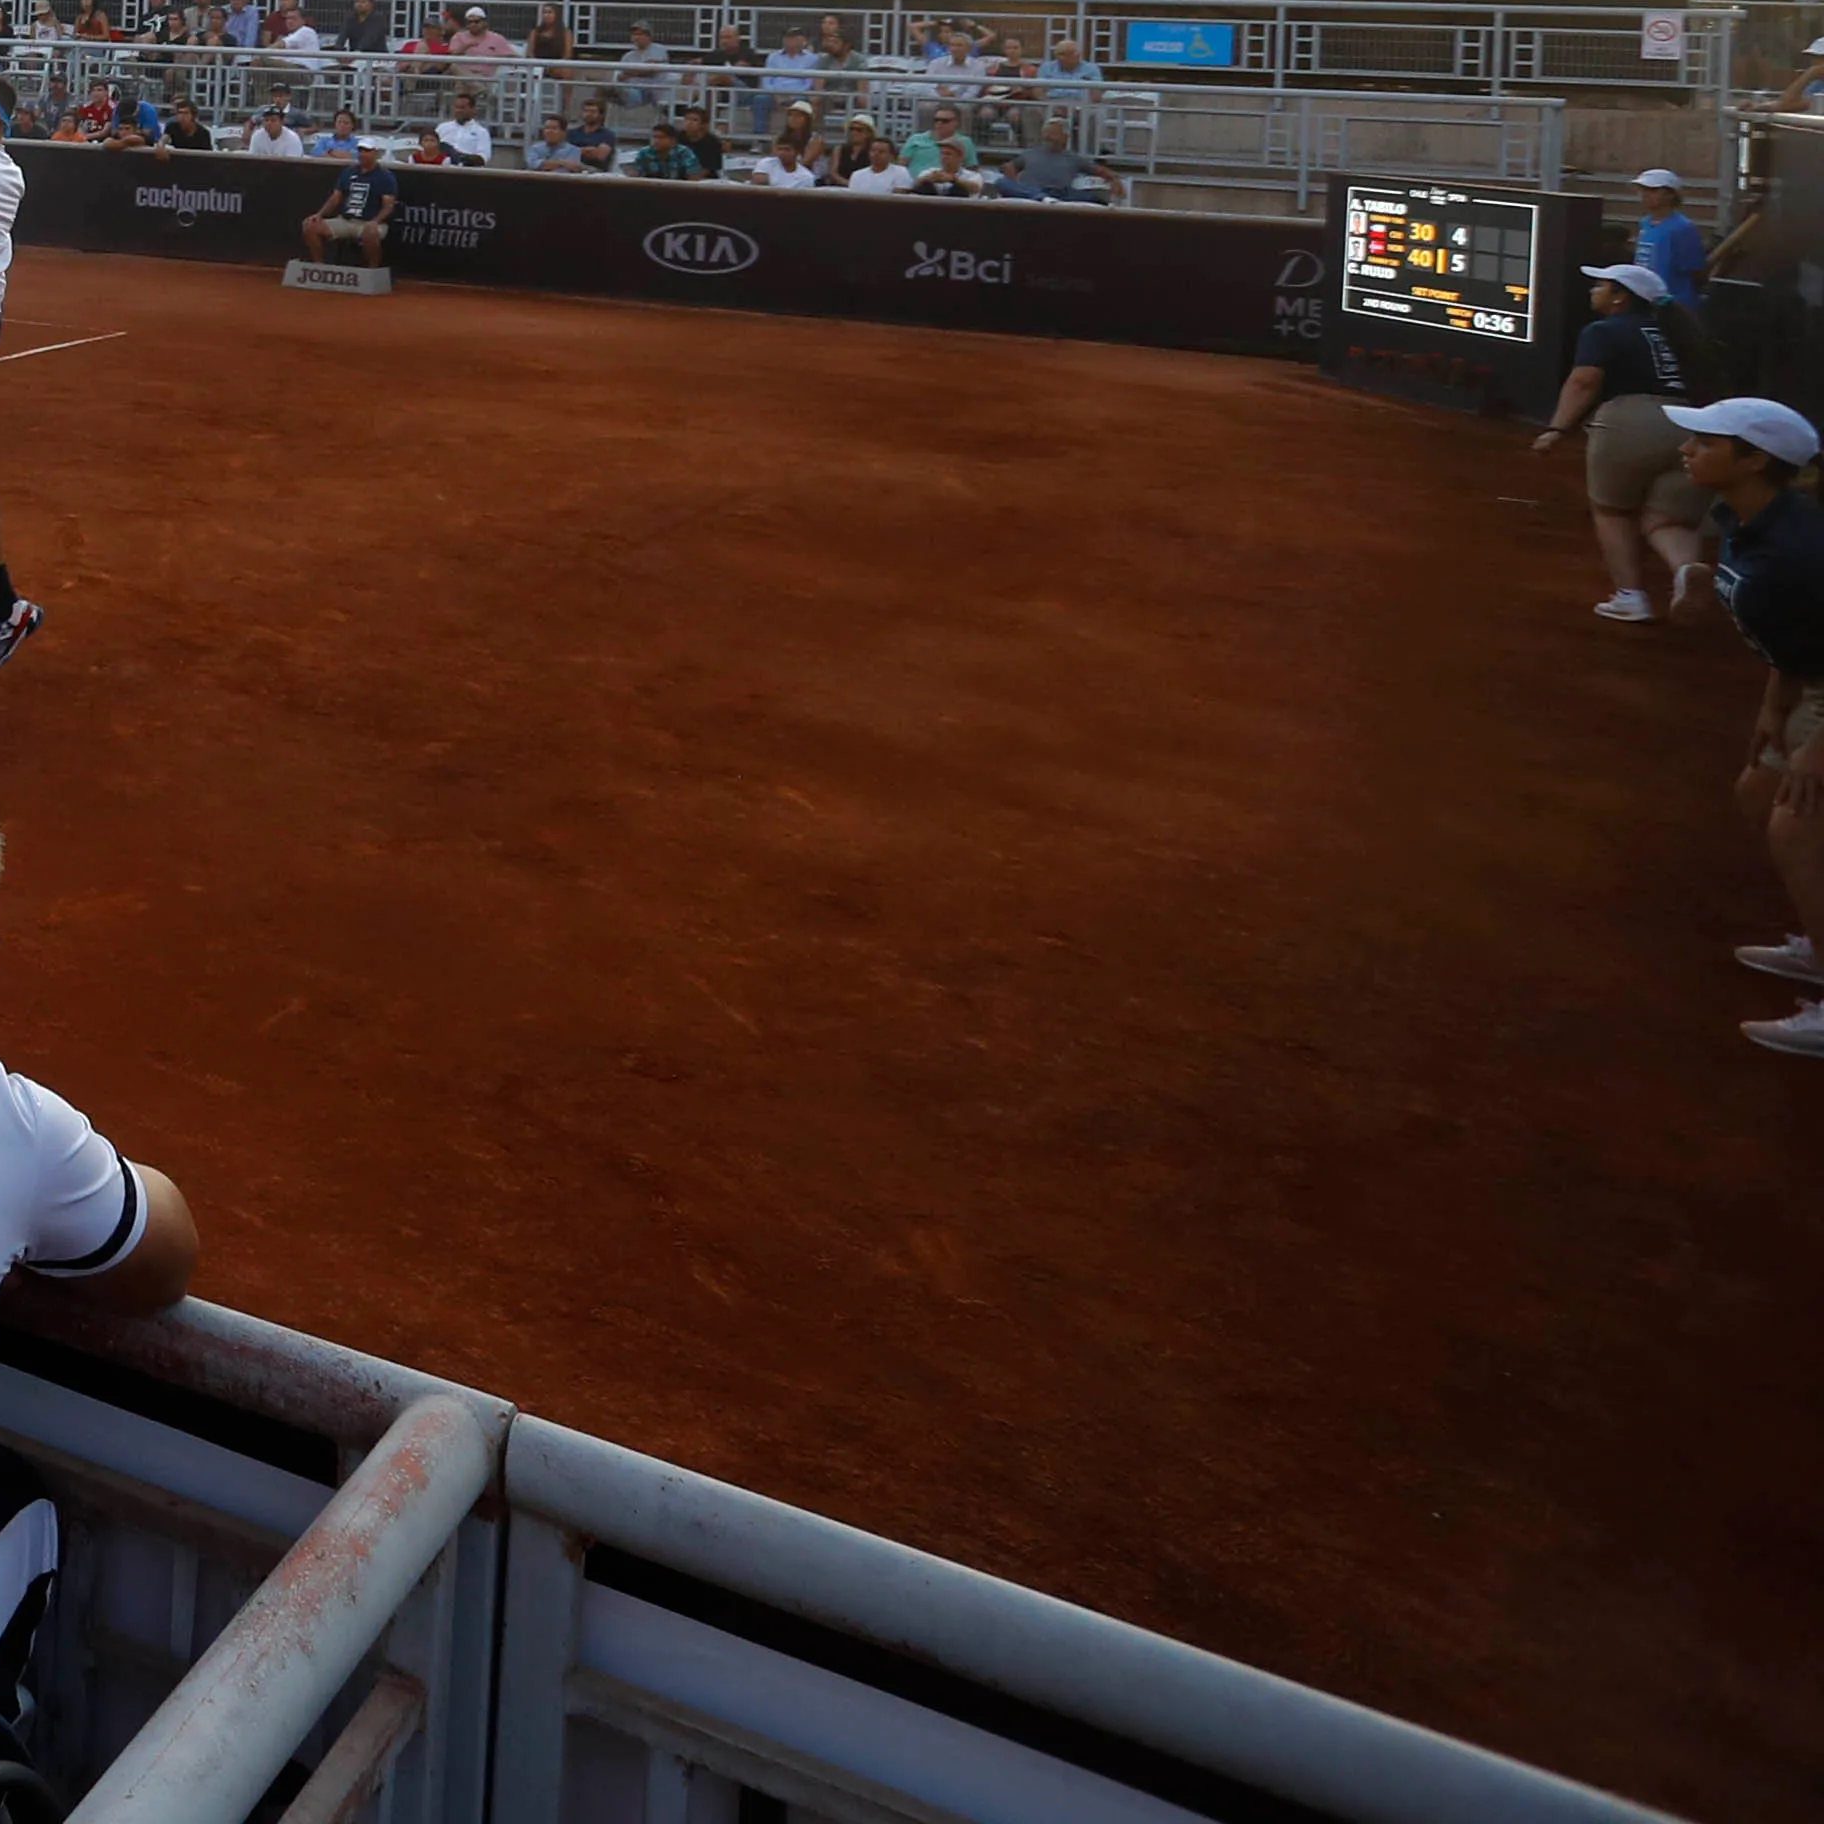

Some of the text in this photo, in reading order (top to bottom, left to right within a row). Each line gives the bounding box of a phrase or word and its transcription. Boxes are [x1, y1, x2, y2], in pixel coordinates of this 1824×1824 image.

[428, 228, 480, 248] BETTER
[1408, 222, 1437, 242] 30
[1452, 227, 1467, 246] 4
[664, 232, 738, 264] KIA
[1407, 248, 1435, 268] 40
[1451, 253, 1467, 272] 5
[951, 251, 1015, 284] Bci
[1473, 312, 1515, 333] 0:36
